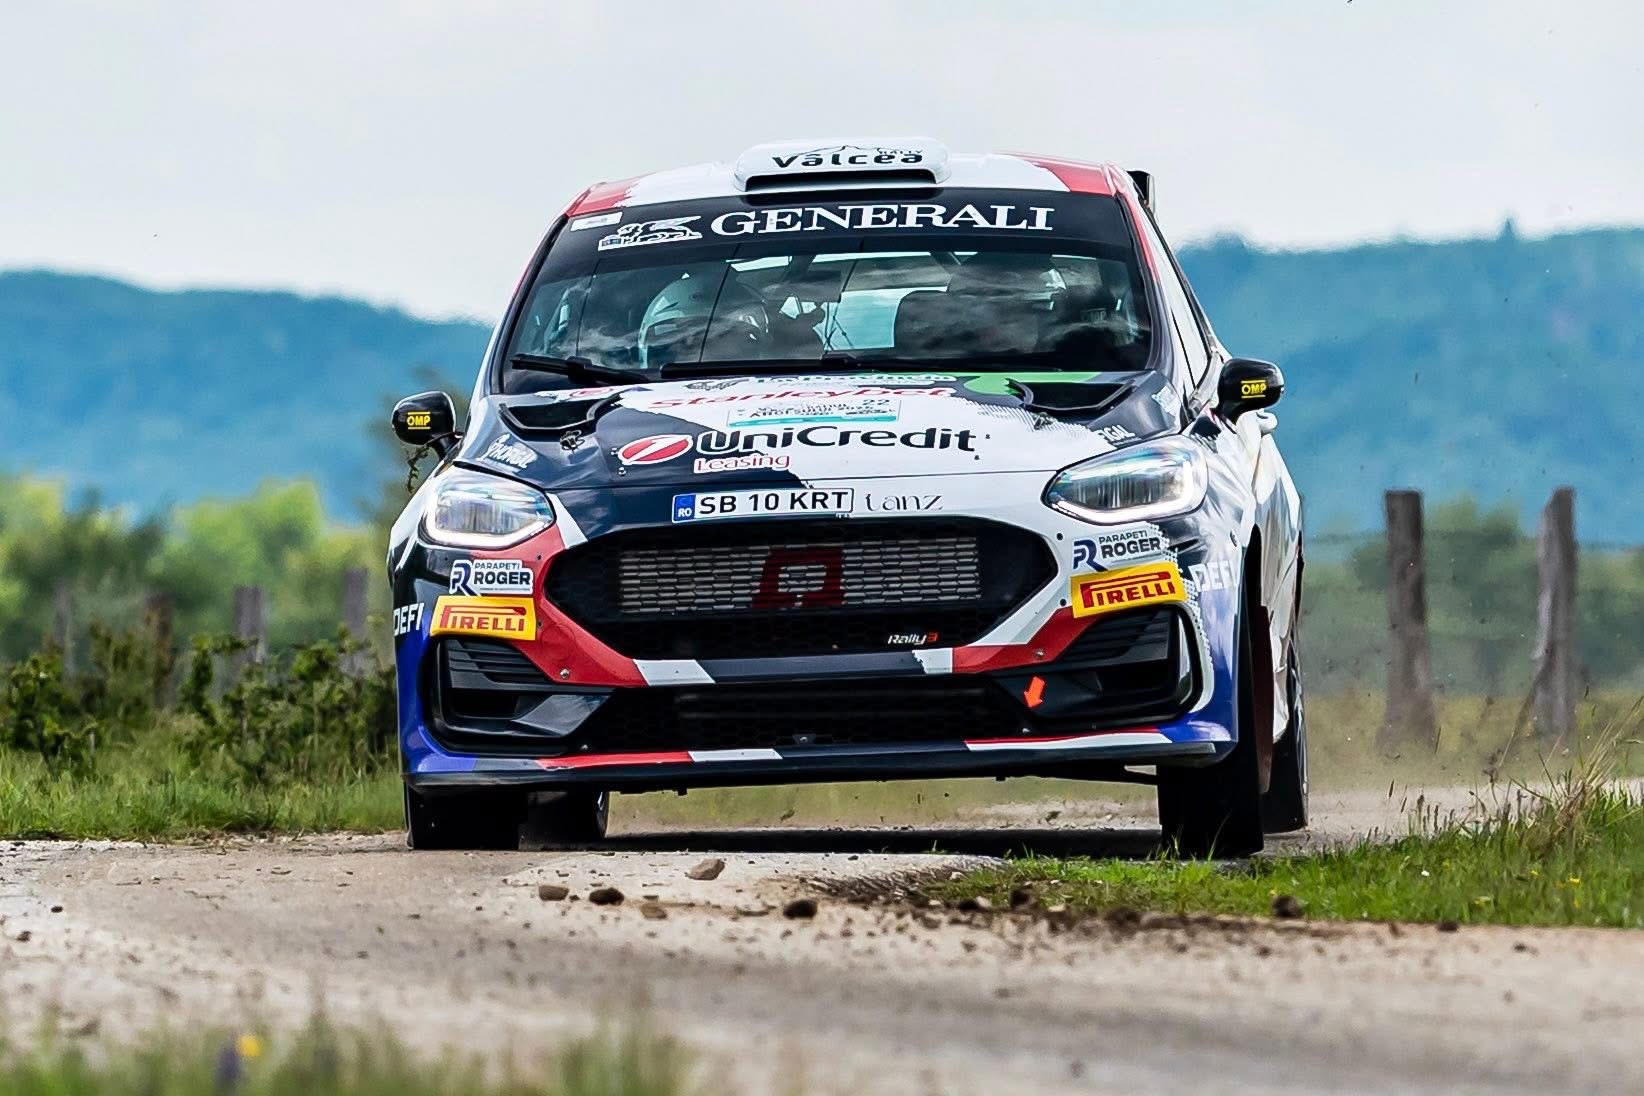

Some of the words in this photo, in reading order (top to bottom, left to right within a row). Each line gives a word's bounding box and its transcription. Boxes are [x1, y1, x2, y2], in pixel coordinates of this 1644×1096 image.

[710, 203, 1055, 235] GENERALI
[1241, 383, 1267, 395] OMP
[406, 414, 431, 427] OMP
[700, 425, 977, 452] UniCredit
[696, 455, 791, 471] Leasing
[700, 495, 737, 515] SB
[748, 492, 779, 512] 10
[789, 491, 849, 511] KRT
[677, 507, 692, 518] RO
[1098, 530, 1148, 544] PARAPETI
[1100, 537, 1161, 559] ROGER
[474, 562, 520, 570] PARAPETI
[473, 571, 531, 586] ROGER
[1080, 571, 1176, 609] PIRELLI
[439, 605, 527, 632] PIRELLI
[887, 632, 939, 646] Rally3
